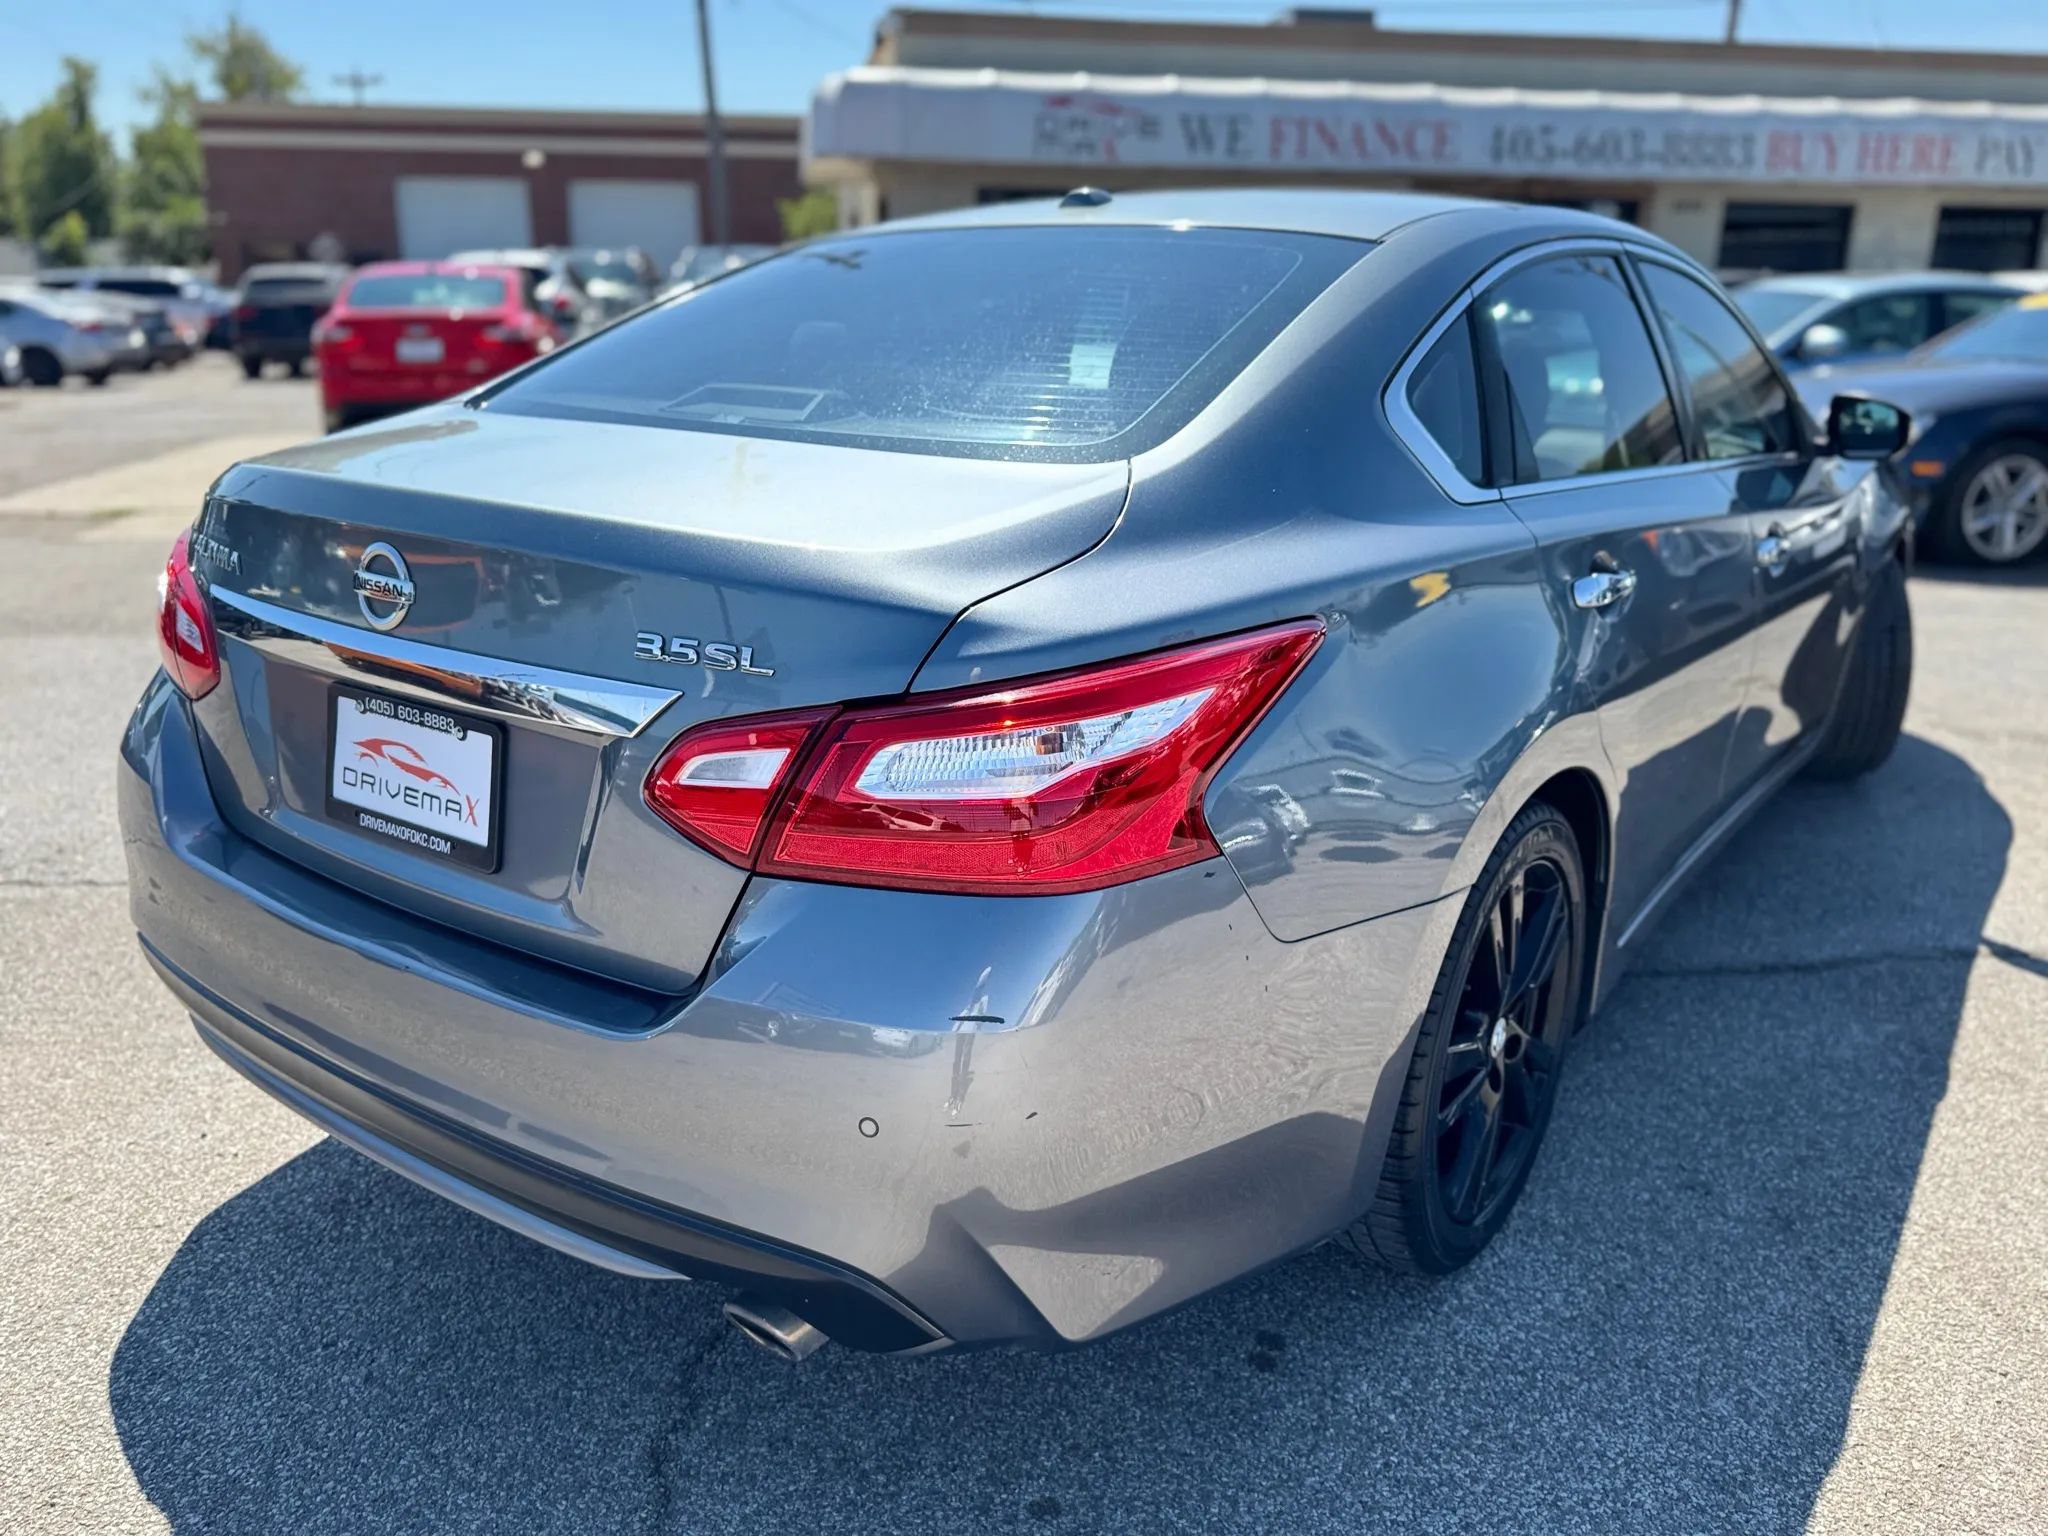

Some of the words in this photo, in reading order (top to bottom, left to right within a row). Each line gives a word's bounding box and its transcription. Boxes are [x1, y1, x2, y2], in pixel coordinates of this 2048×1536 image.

[1179, 113, 1254, 160] WE
[1268, 116, 1459, 162] FINANCE
[1764, 129, 1840, 174] BUY
[1855, 130, 1958, 176] HERE
[353, 572, 403, 597] NISSAN
[364, 696, 395, 717] (405)
[397, 705, 455, 733] 603-8883
[342, 766, 480, 827] DRIVEMAX
[359, 812, 451, 855] DRIVEMAXOFOKC.COM
